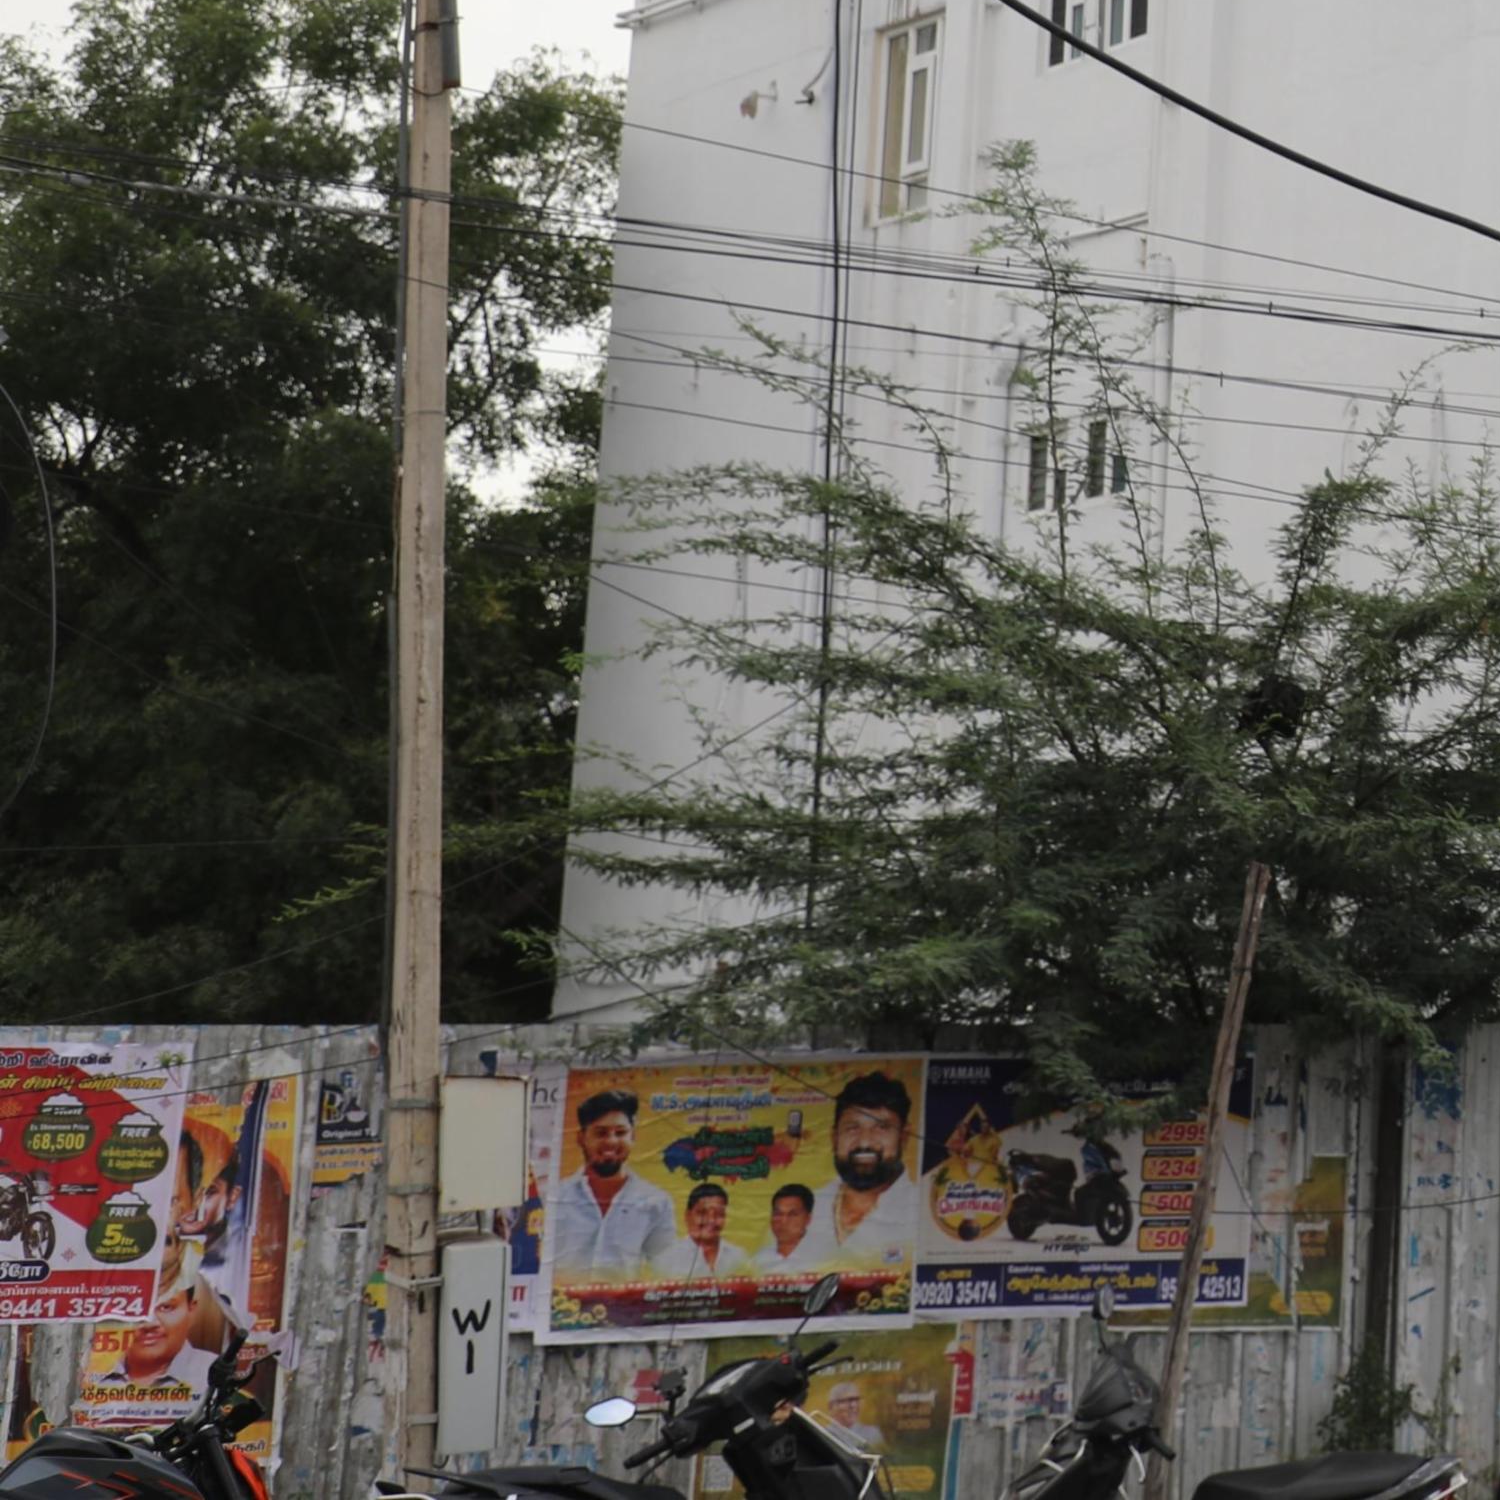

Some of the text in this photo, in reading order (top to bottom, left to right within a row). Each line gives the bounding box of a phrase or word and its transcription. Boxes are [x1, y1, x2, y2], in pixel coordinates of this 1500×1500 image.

[941, 1065, 992, 1080] YAMAHA
[119, 1126, 150, 1139] FREE
[321, 1129, 363, 1140] Original
[107, 1206, 140, 1218] FREE
[1202, 1276, 1242, 1299] 42513
[68, 1297, 144, 1317] 35724
[452, 1299, 492, 1335] W
